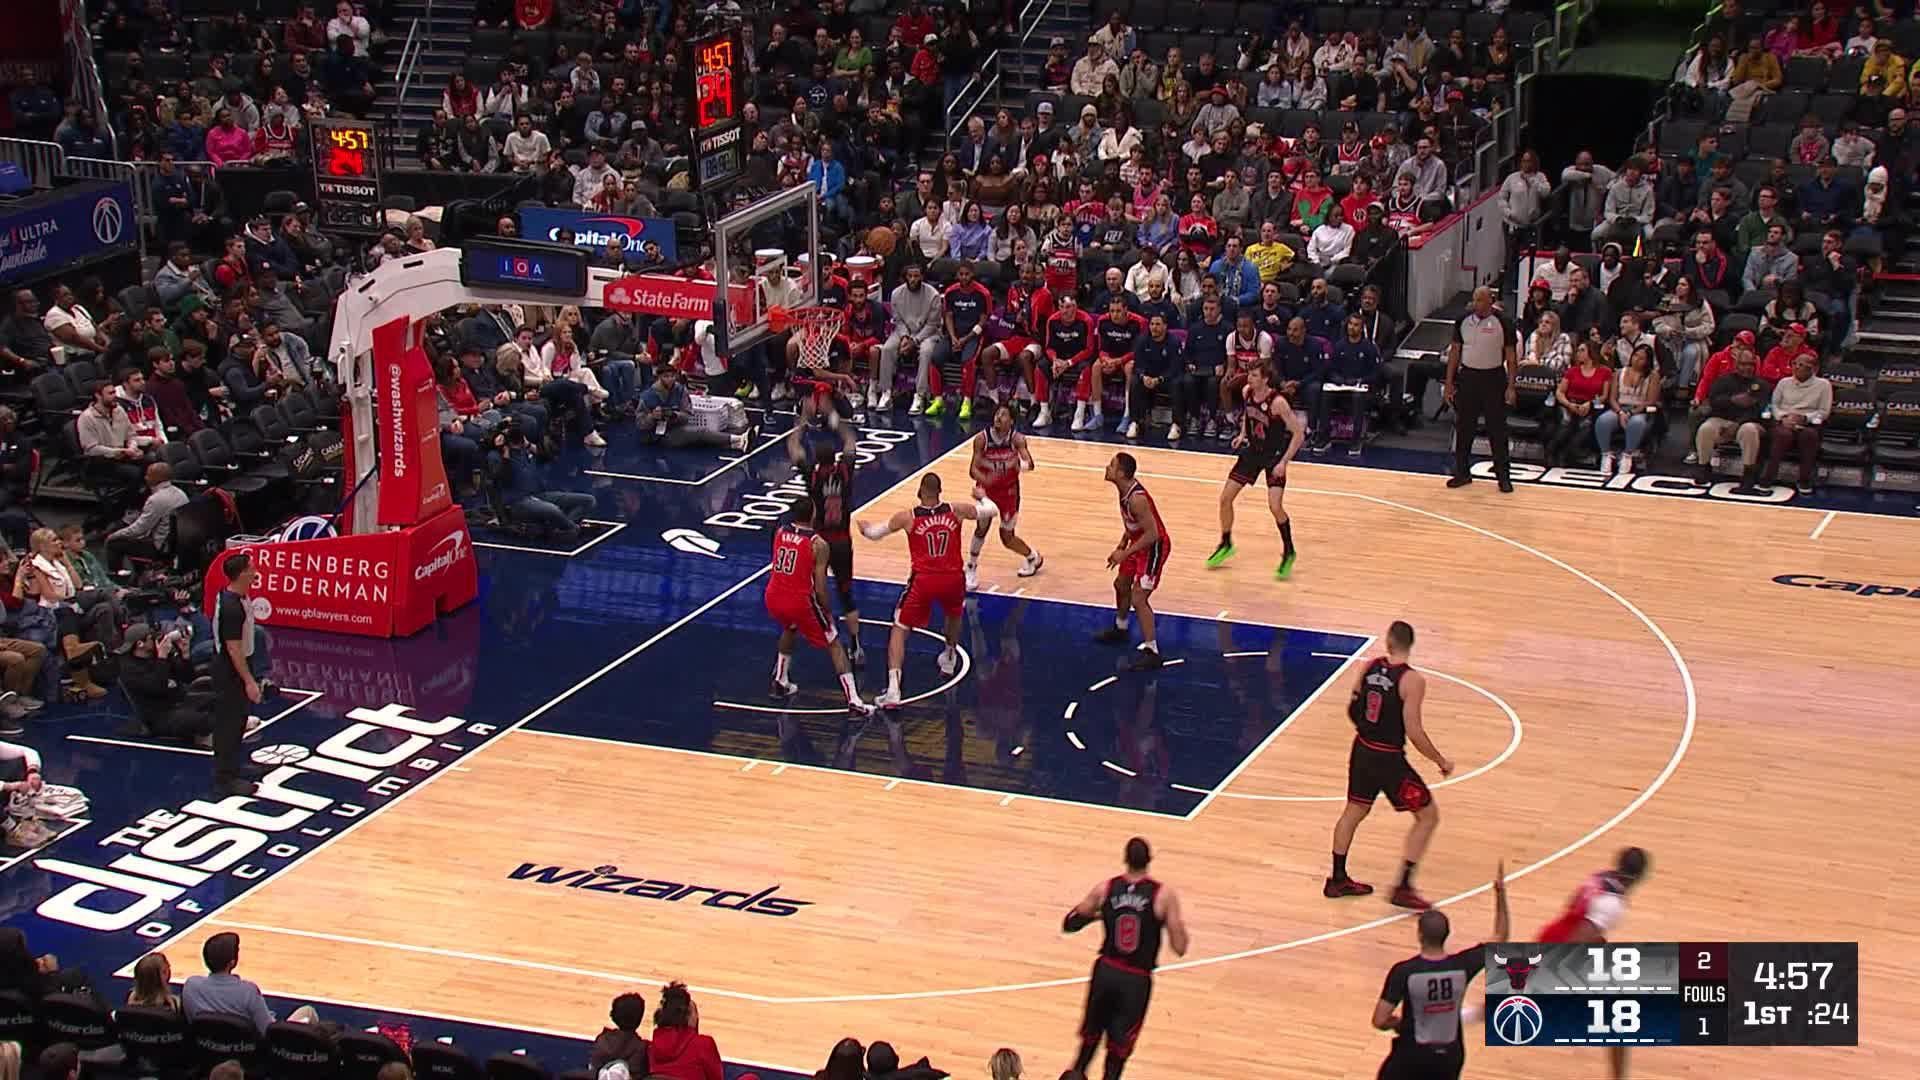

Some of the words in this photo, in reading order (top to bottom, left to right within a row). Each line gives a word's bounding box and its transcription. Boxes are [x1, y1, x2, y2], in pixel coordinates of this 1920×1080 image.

[703, 42, 732, 71] 4:57
[331, 130, 368, 149] 4:57
[712, 128, 740, 148] TISSOT
[334, 184, 375, 195] TISSOT
[20, 218, 58, 240] ULTRA
[1516, 376, 1554, 386] CAESARS
[390, 363, 407, 478] @washwizards
[1469, 460, 1796, 503] GEICO
[926, 531, 949, 558] 17
[774, 546, 798, 575] 33
[275, 605, 373, 625] www.gblawyers.com
[99, 808, 183, 848] THE
[135, 898, 204, 939] OF
[231, 722, 498, 880] COLUMBIA
[506, 862, 816, 917] wizards
[1427, 977, 1453, 1001] 28
